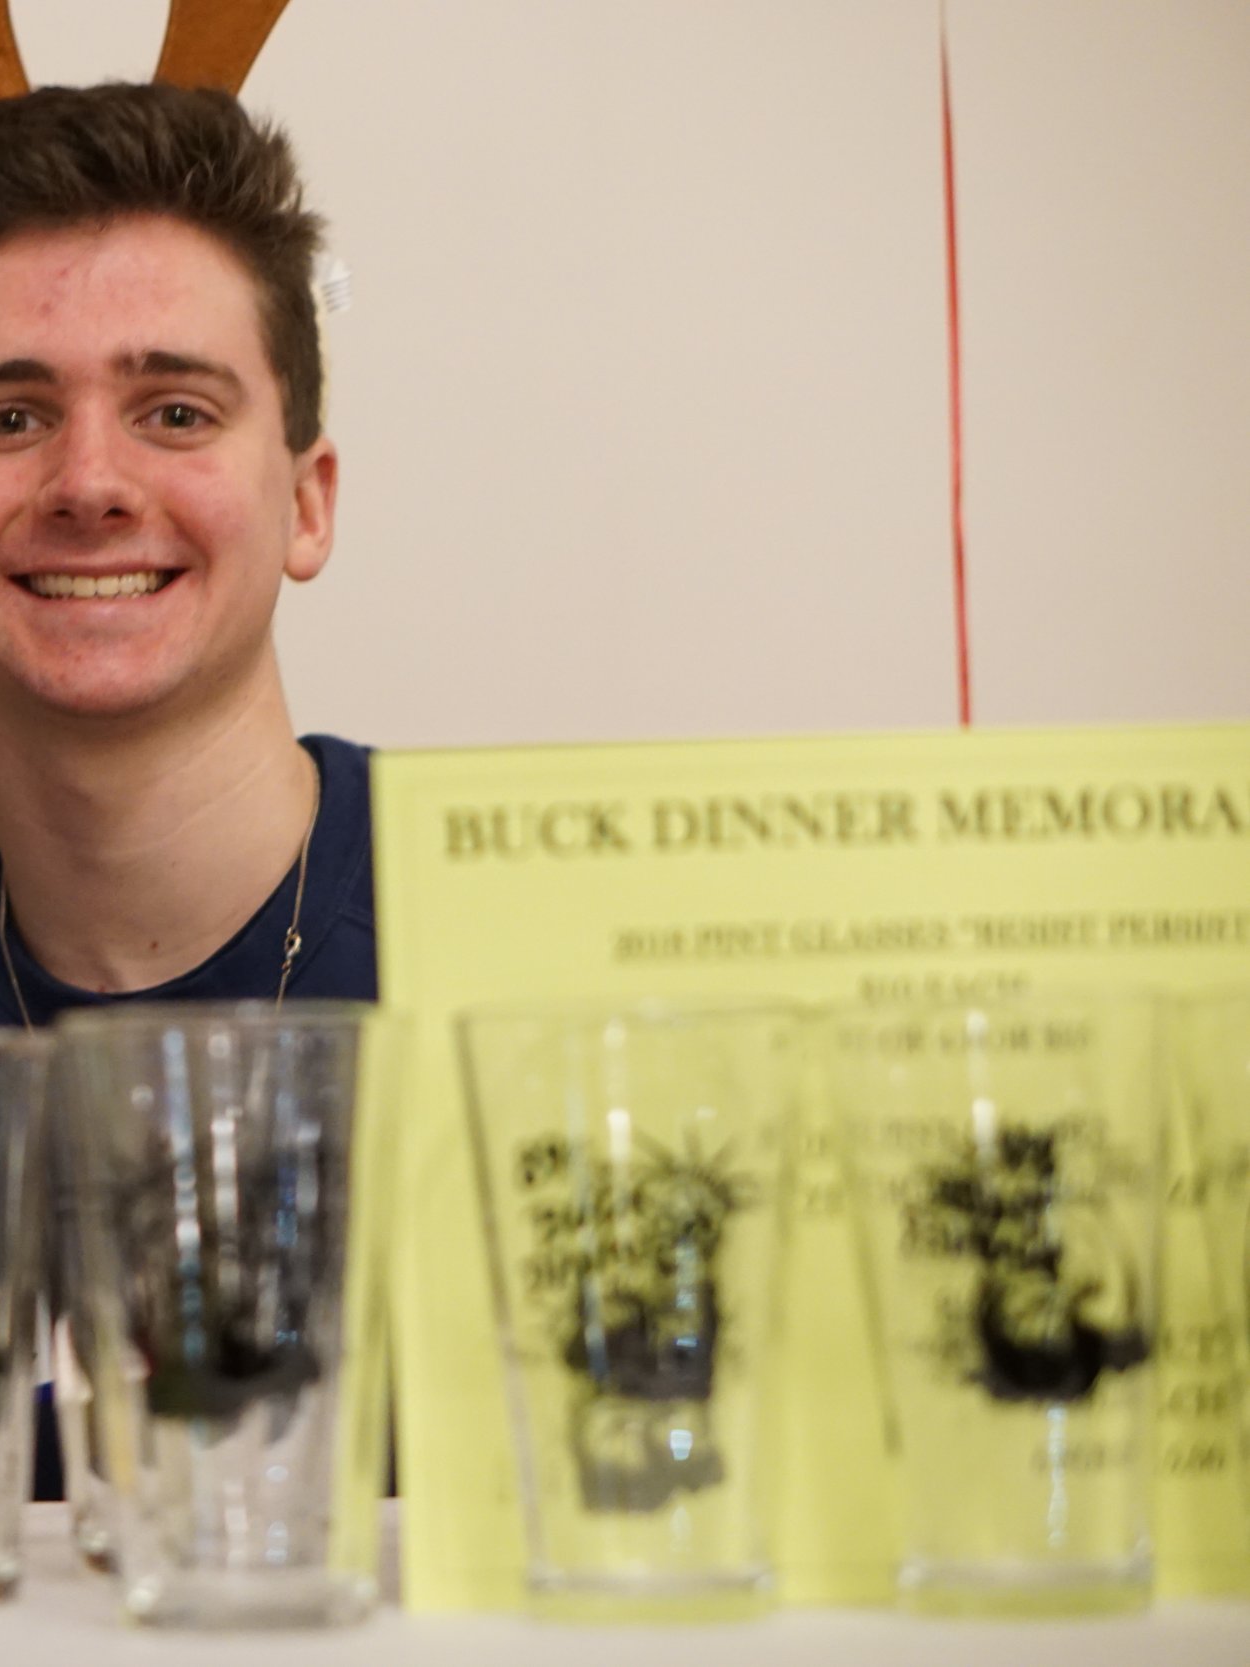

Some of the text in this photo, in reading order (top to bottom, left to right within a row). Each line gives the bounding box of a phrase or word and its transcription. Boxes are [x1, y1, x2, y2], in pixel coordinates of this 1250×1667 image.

[444, 781, 1247, 860] BUCK DINNER MEMORA
